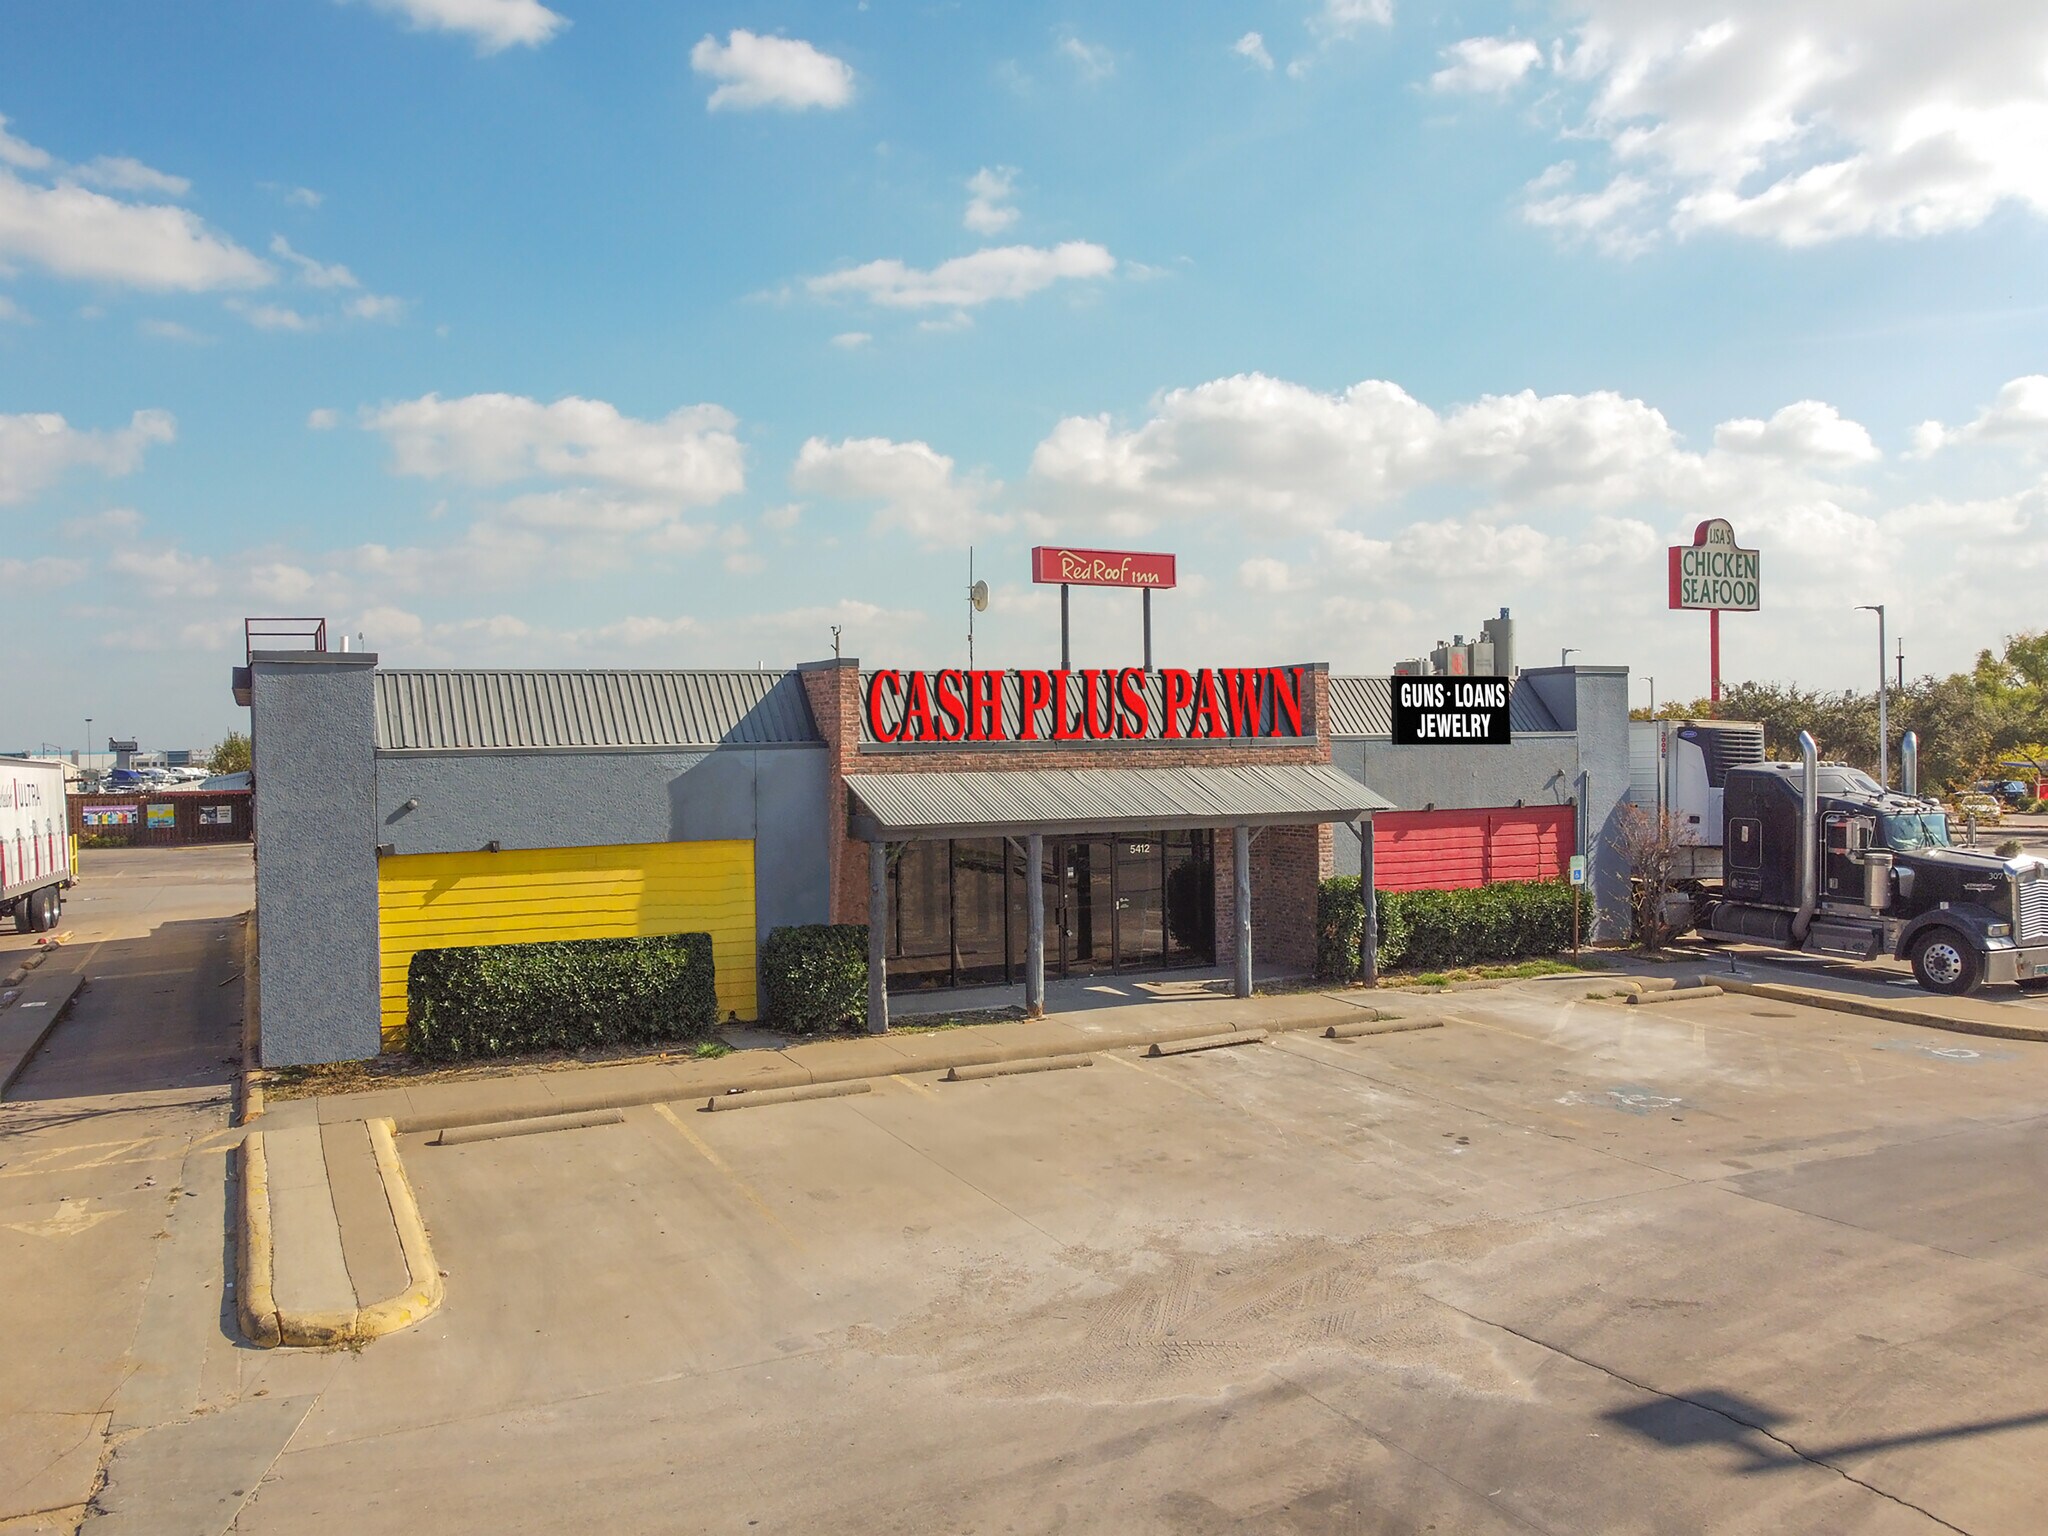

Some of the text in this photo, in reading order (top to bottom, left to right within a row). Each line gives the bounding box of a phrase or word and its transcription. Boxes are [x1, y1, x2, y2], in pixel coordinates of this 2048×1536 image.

[1709, 528, 1731, 545] LISA'S
[1062, 557, 1092, 580] Red
[1093, 557, 1132, 581] Roof
[1683, 550, 1756, 579] CHICKEN
[1682, 578, 1757, 606] SEAFOOD
[868, 667, 1305, 742] CASH PLUS PAWN
[1401, 682, 1506, 708] GUNS LOANS
[1416, 713, 1491, 738] JEWELRY
[17, 783, 42, 807] ULTRA
[1129, 843, 1150, 854] 5412
[1988, 872, 2004, 881] 307
